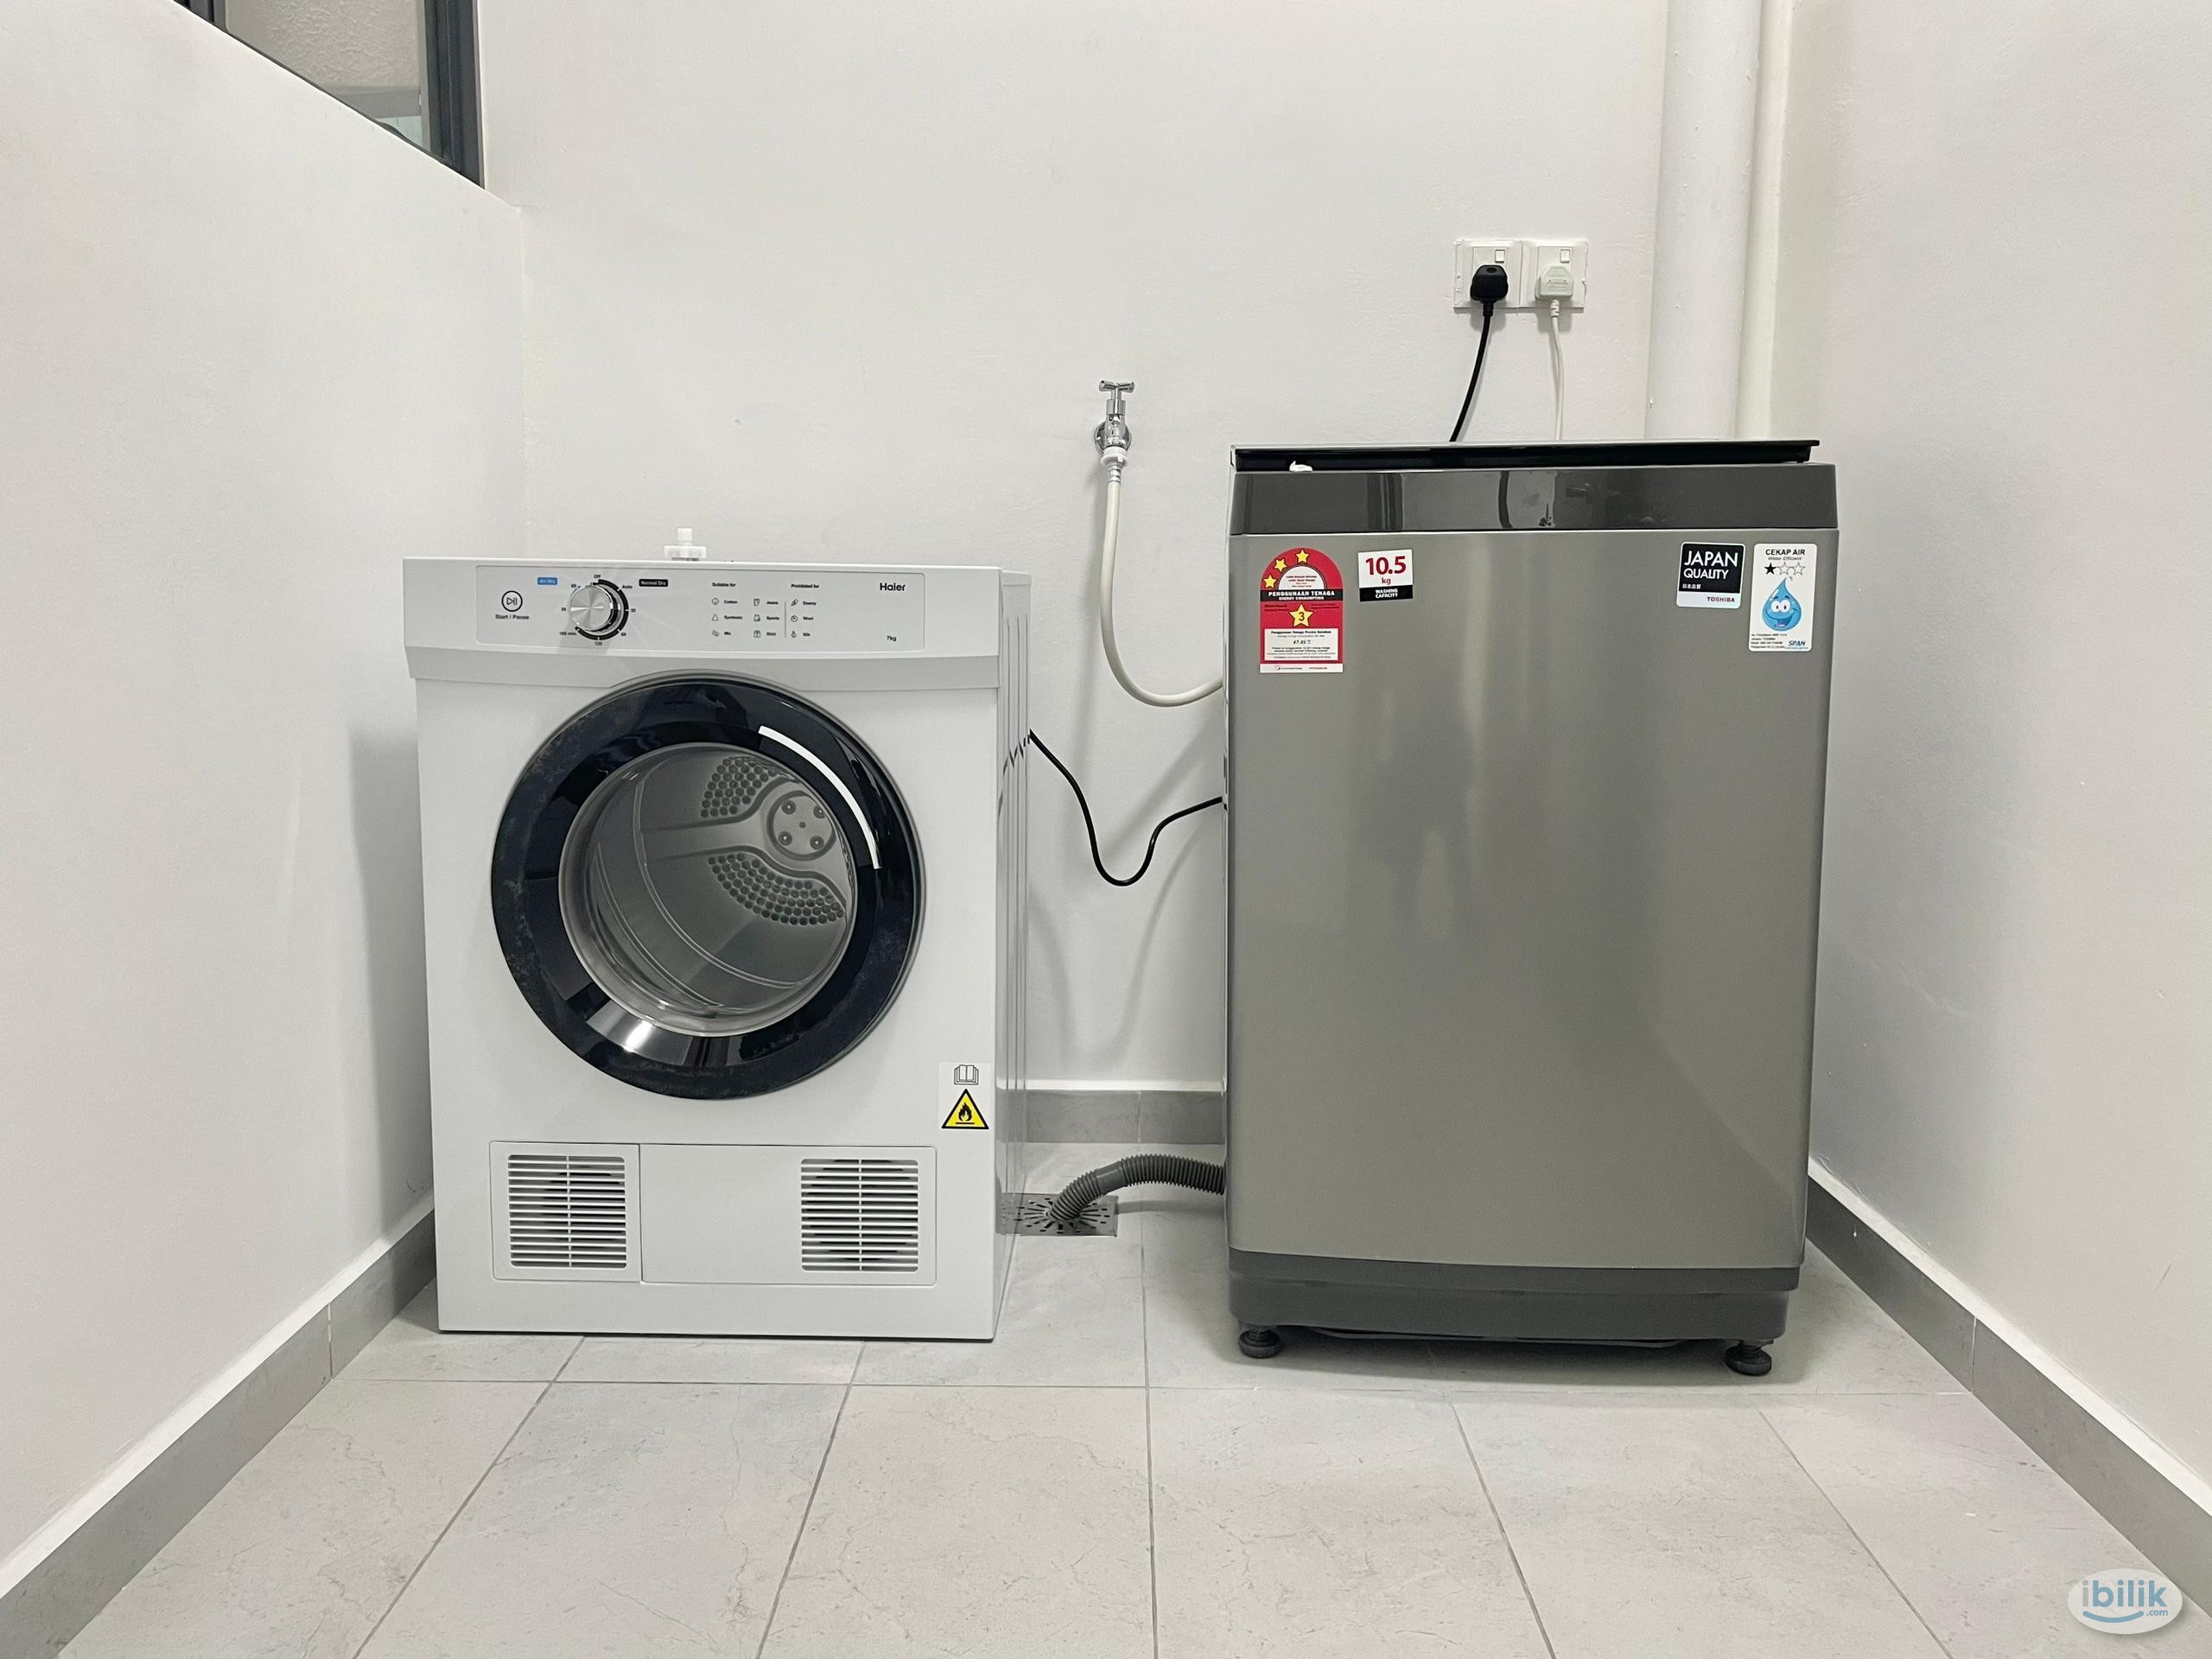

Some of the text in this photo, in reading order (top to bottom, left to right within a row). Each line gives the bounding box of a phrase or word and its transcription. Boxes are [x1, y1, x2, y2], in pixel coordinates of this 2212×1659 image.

[1684, 550, 1738, 568] JAPAN
[1365, 556, 1407, 575] 10.5
[1683, 568, 1729, 580] QUALITY
[880, 582, 906, 592] Haier
[1298, 612, 1306, 621] 3
